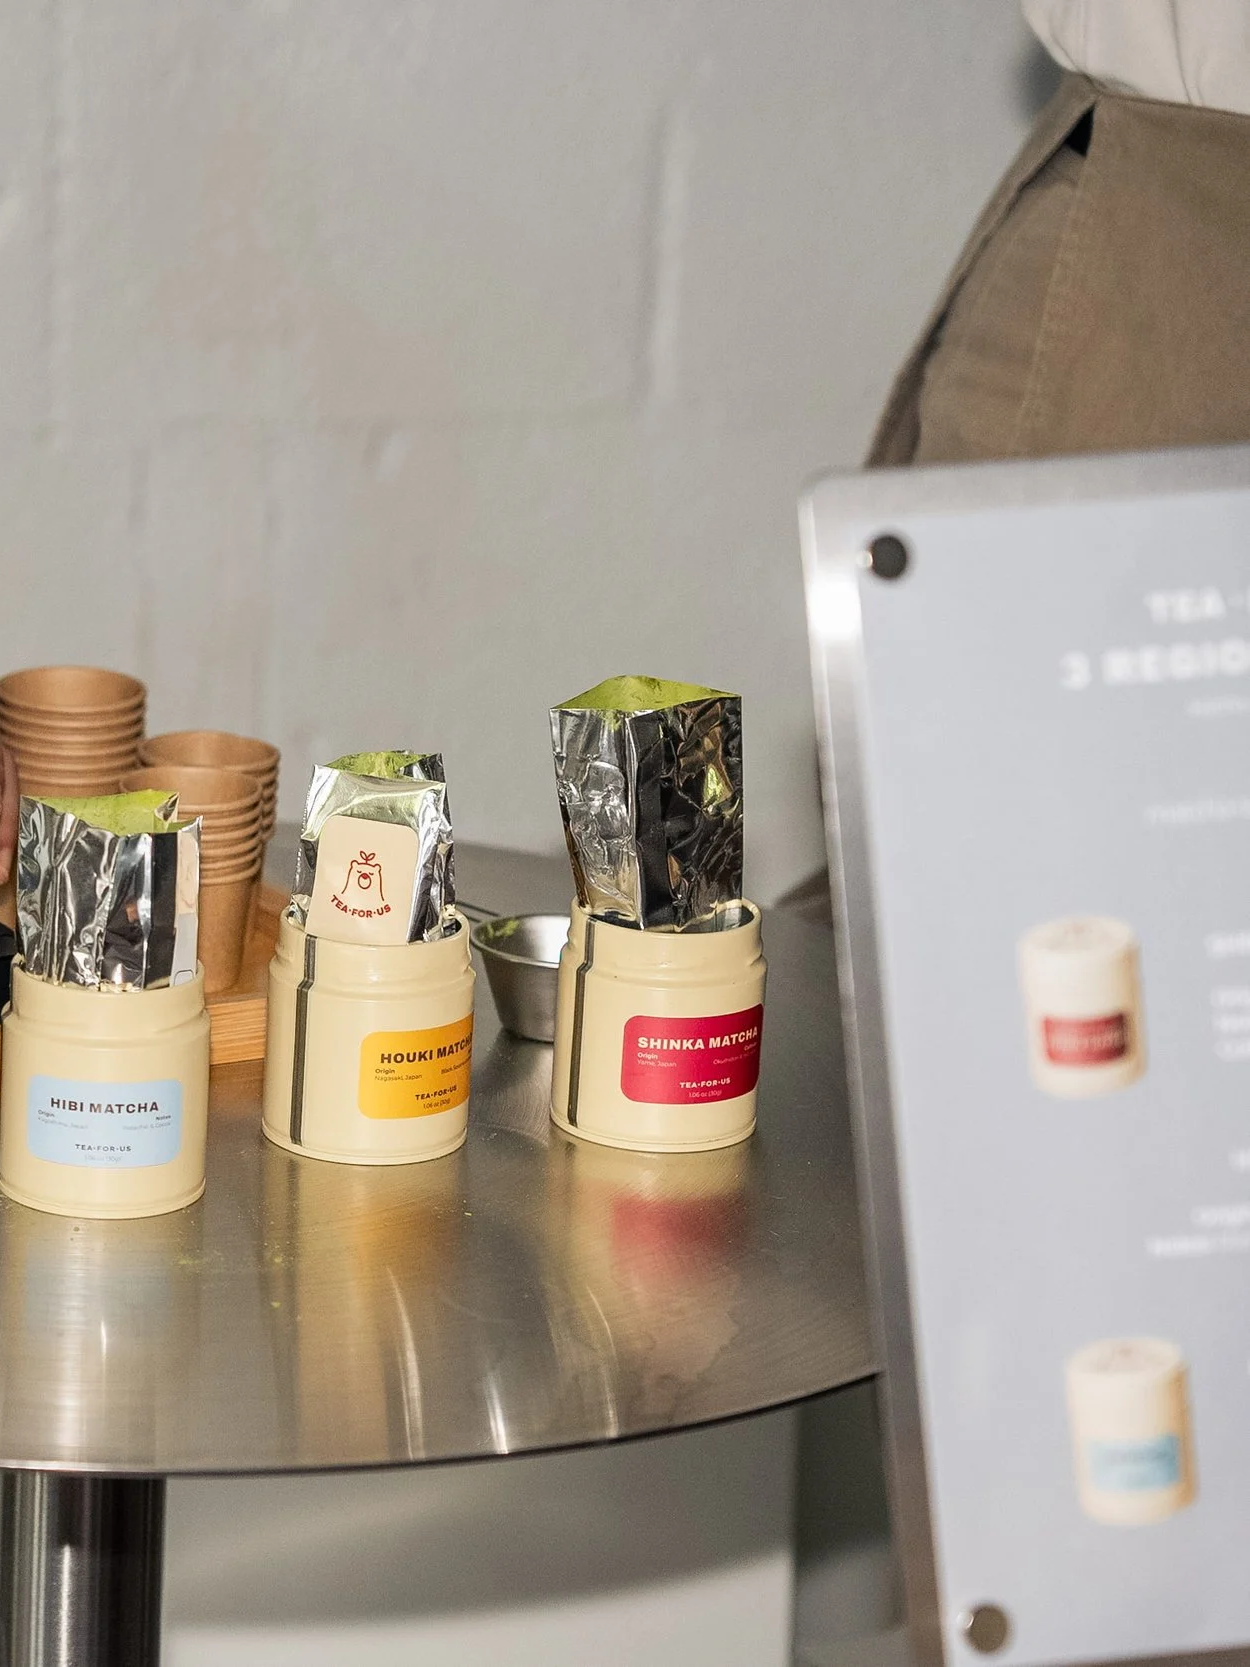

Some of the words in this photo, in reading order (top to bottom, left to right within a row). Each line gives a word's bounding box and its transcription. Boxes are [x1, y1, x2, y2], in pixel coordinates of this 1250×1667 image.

[637, 1036, 705, 1050] SHINKA
[708, 1026, 758, 1049] MATCHA
[380, 1050, 433, 1064] HOUKI
[637, 1052, 659, 1061] Origin
[657, 1061, 677, 1069] Japan
[50, 1097, 84, 1112] HIBI
[89, 1101, 159, 1114] MATCHA
